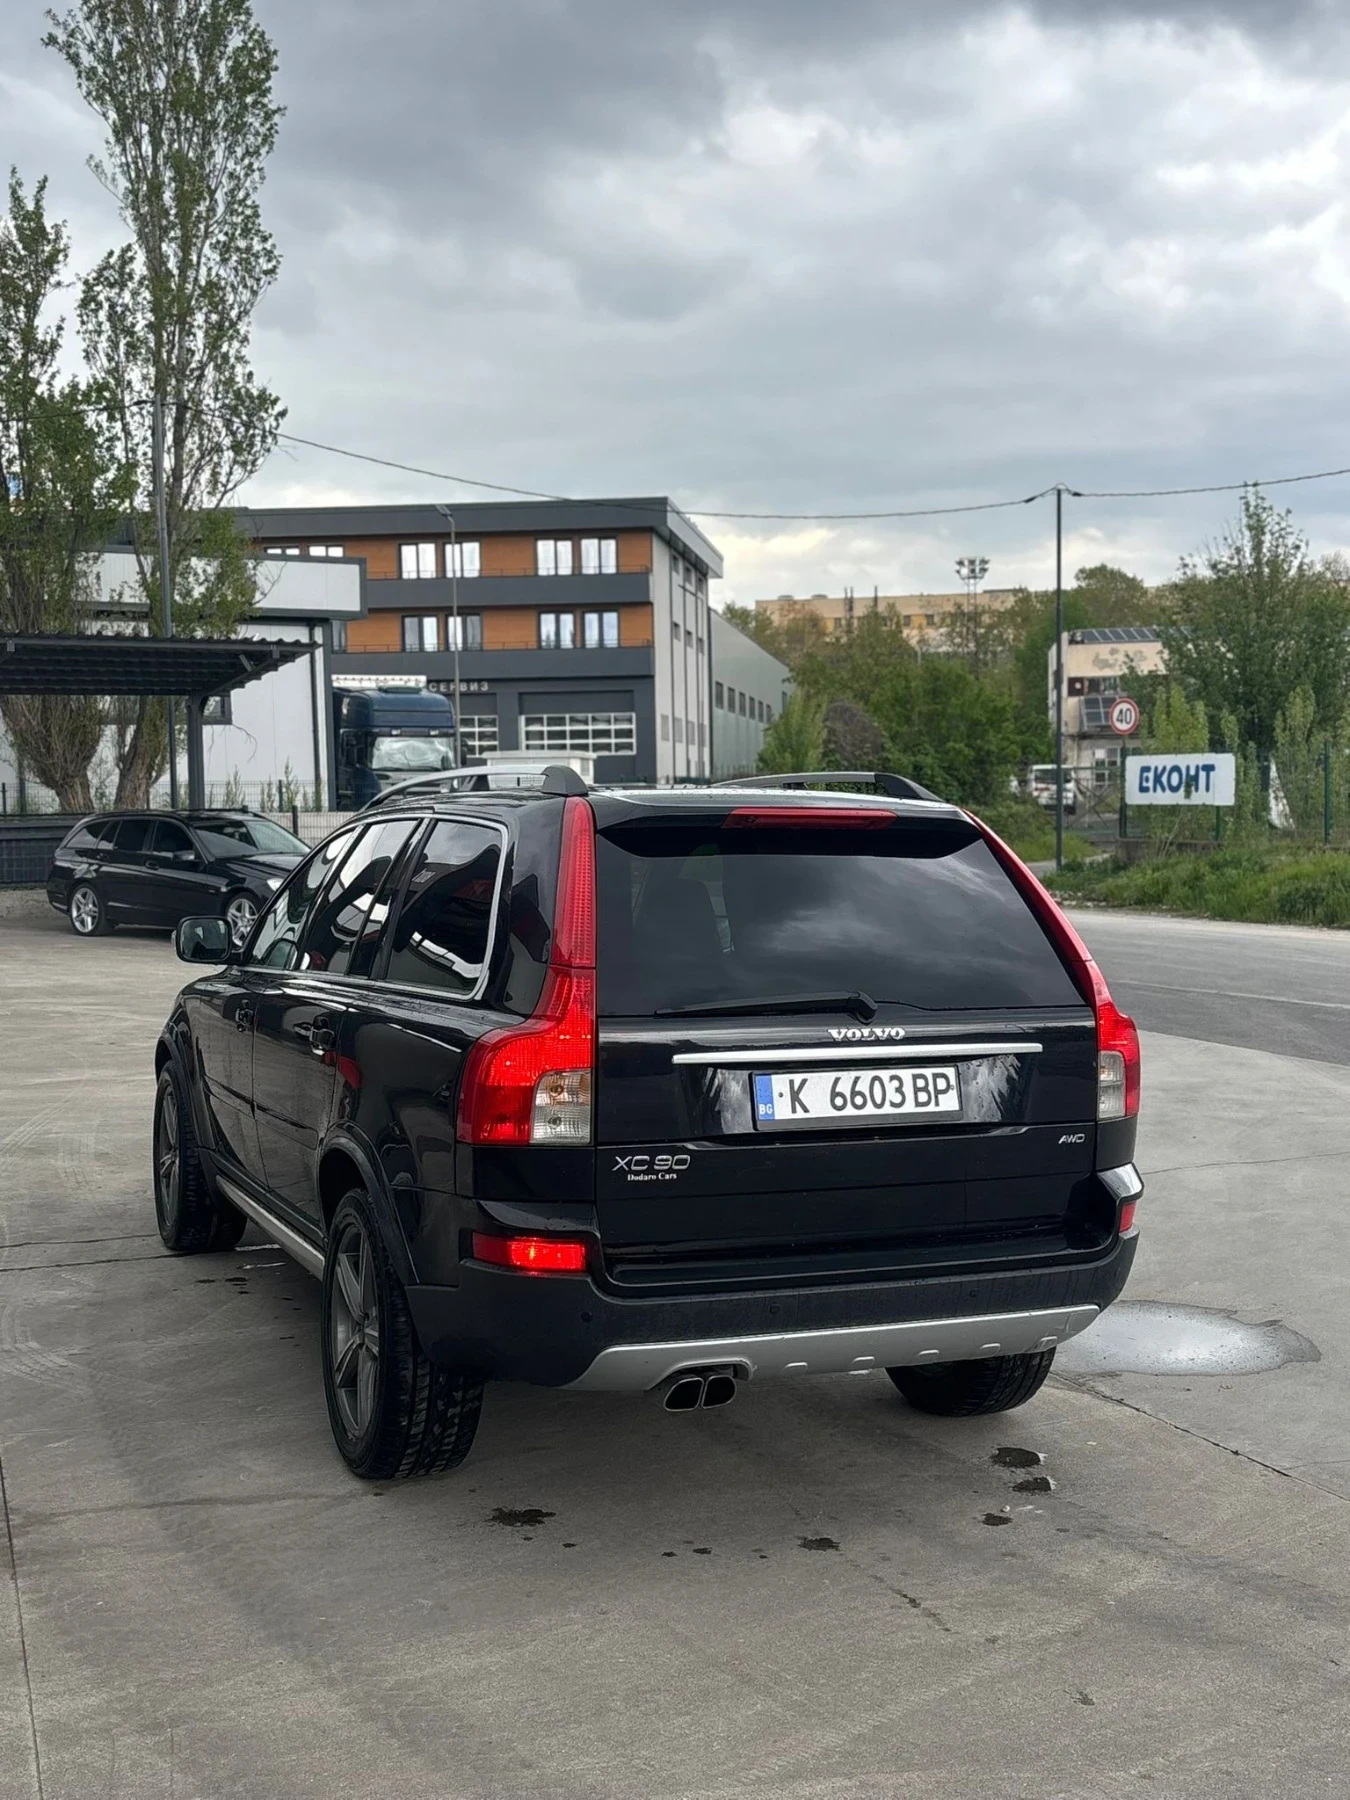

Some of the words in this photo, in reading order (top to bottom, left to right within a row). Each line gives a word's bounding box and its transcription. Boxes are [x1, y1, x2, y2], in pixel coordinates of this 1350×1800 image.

[428, 681, 489, 692] СЕРВИЗ
[1116, 708, 1132, 725] 40
[1138, 764, 1215, 794] ЕКОНТ
[828, 1027, 906, 1041] VOLVO
[788, 1078, 810, 1114] K
[829, 1074, 906, 1112] 6603
[911, 1072, 951, 1108] BP
[759, 1103, 773, 1115] BG
[1058, 1133, 1085, 1144] AWD
[658, 1171, 677, 1180] Cars
